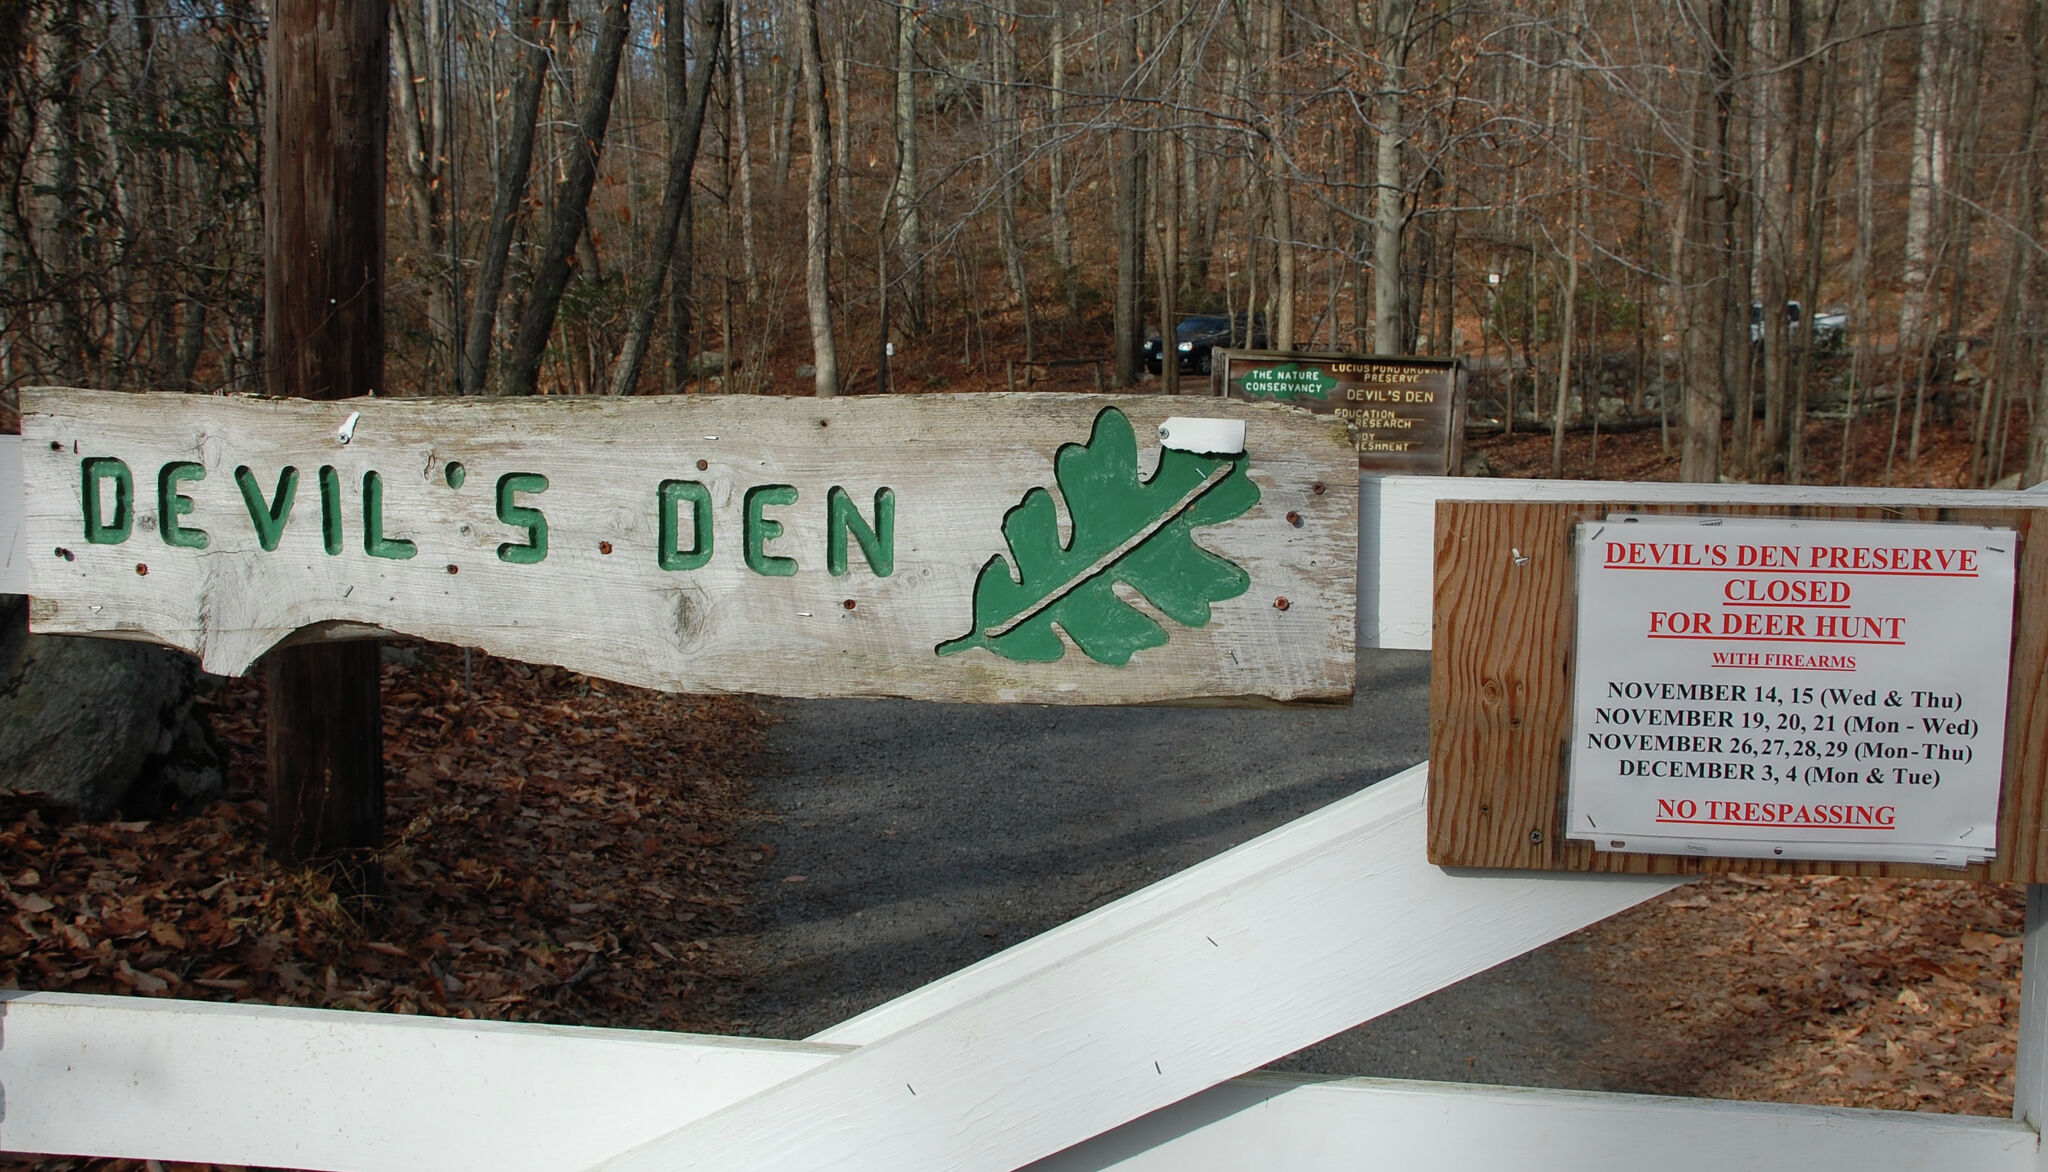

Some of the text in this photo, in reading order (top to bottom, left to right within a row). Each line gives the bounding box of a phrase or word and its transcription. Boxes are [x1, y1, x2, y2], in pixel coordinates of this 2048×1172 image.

[1253, 370, 1320, 381] THE NATURE
[1331, 363, 1370, 373] LUCIUS
[1373, 365, 1400, 374] POND
[1364, 373, 1420, 383] PRESERVE
[1245, 382, 1323, 393] CONSERVANCY
[1347, 389, 1434, 403] DEVIL'S DEN
[1334, 408, 1395, 419] EDUCATION
[1355, 419, 1411, 429] RESEARCH
[1357, 432, 1375, 440] DY
[1357, 441, 1409, 452] ESHMENT
[81, 457, 896, 578] DEVIL'S DEN
[1605, 542, 1978, 571] DEVIL'S DEN PRESERVE
[1724, 579, 1851, 603] CLOSED
[1649, 611, 1906, 639] FOR DEER HUNT
[1712, 652, 1857, 669] WITH FIREARMS
[1607, 681, 1962, 712] NOVEMBER 14, 15 (Wed & Thu)
[1595, 707, 1734, 728] NOVEMBER
[1741, 712, 1770, 732] 19,
[1776, 713, 1806, 733] 20,
[1813, 714, 1836, 732] 21
[1844, 715, 1899, 737] (Mon
[1921, 717, 1979, 739] Wed)
[1587, 733, 1723, 753] NOVEMBER
[1618, 759, 1940, 790] DECEMBER 3, 4 (Mon & Tue)
[1656, 799, 1896, 826] NO TRESPASSING
